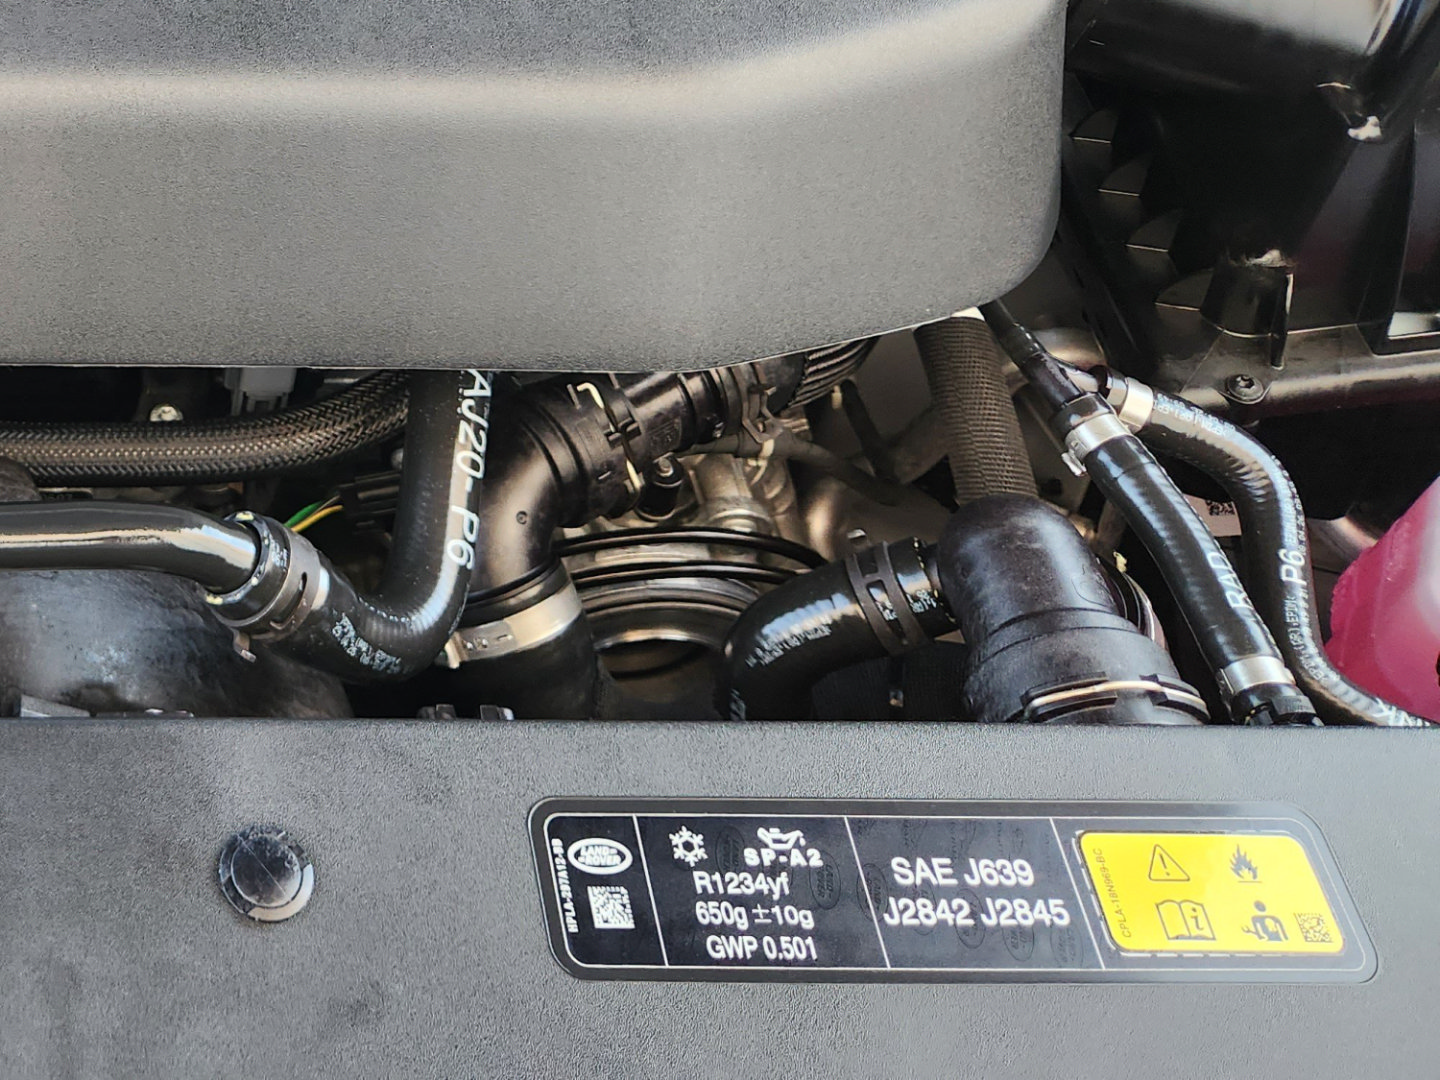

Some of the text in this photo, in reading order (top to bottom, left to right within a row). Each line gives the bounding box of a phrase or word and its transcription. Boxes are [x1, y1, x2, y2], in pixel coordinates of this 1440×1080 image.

[1206, 551, 1255, 611] RAD
[1278, 548, 1308, 587] P6
[743, 847, 825, 868] SP-A2
[890, 856, 1035, 887] SAE J639
[692, 870, 790, 901] R1234yf
[695, 900, 749, 930] 650g
[883, 896, 1071, 927] J2842 J2845
[705, 935, 818, 961] GWP 0.501
